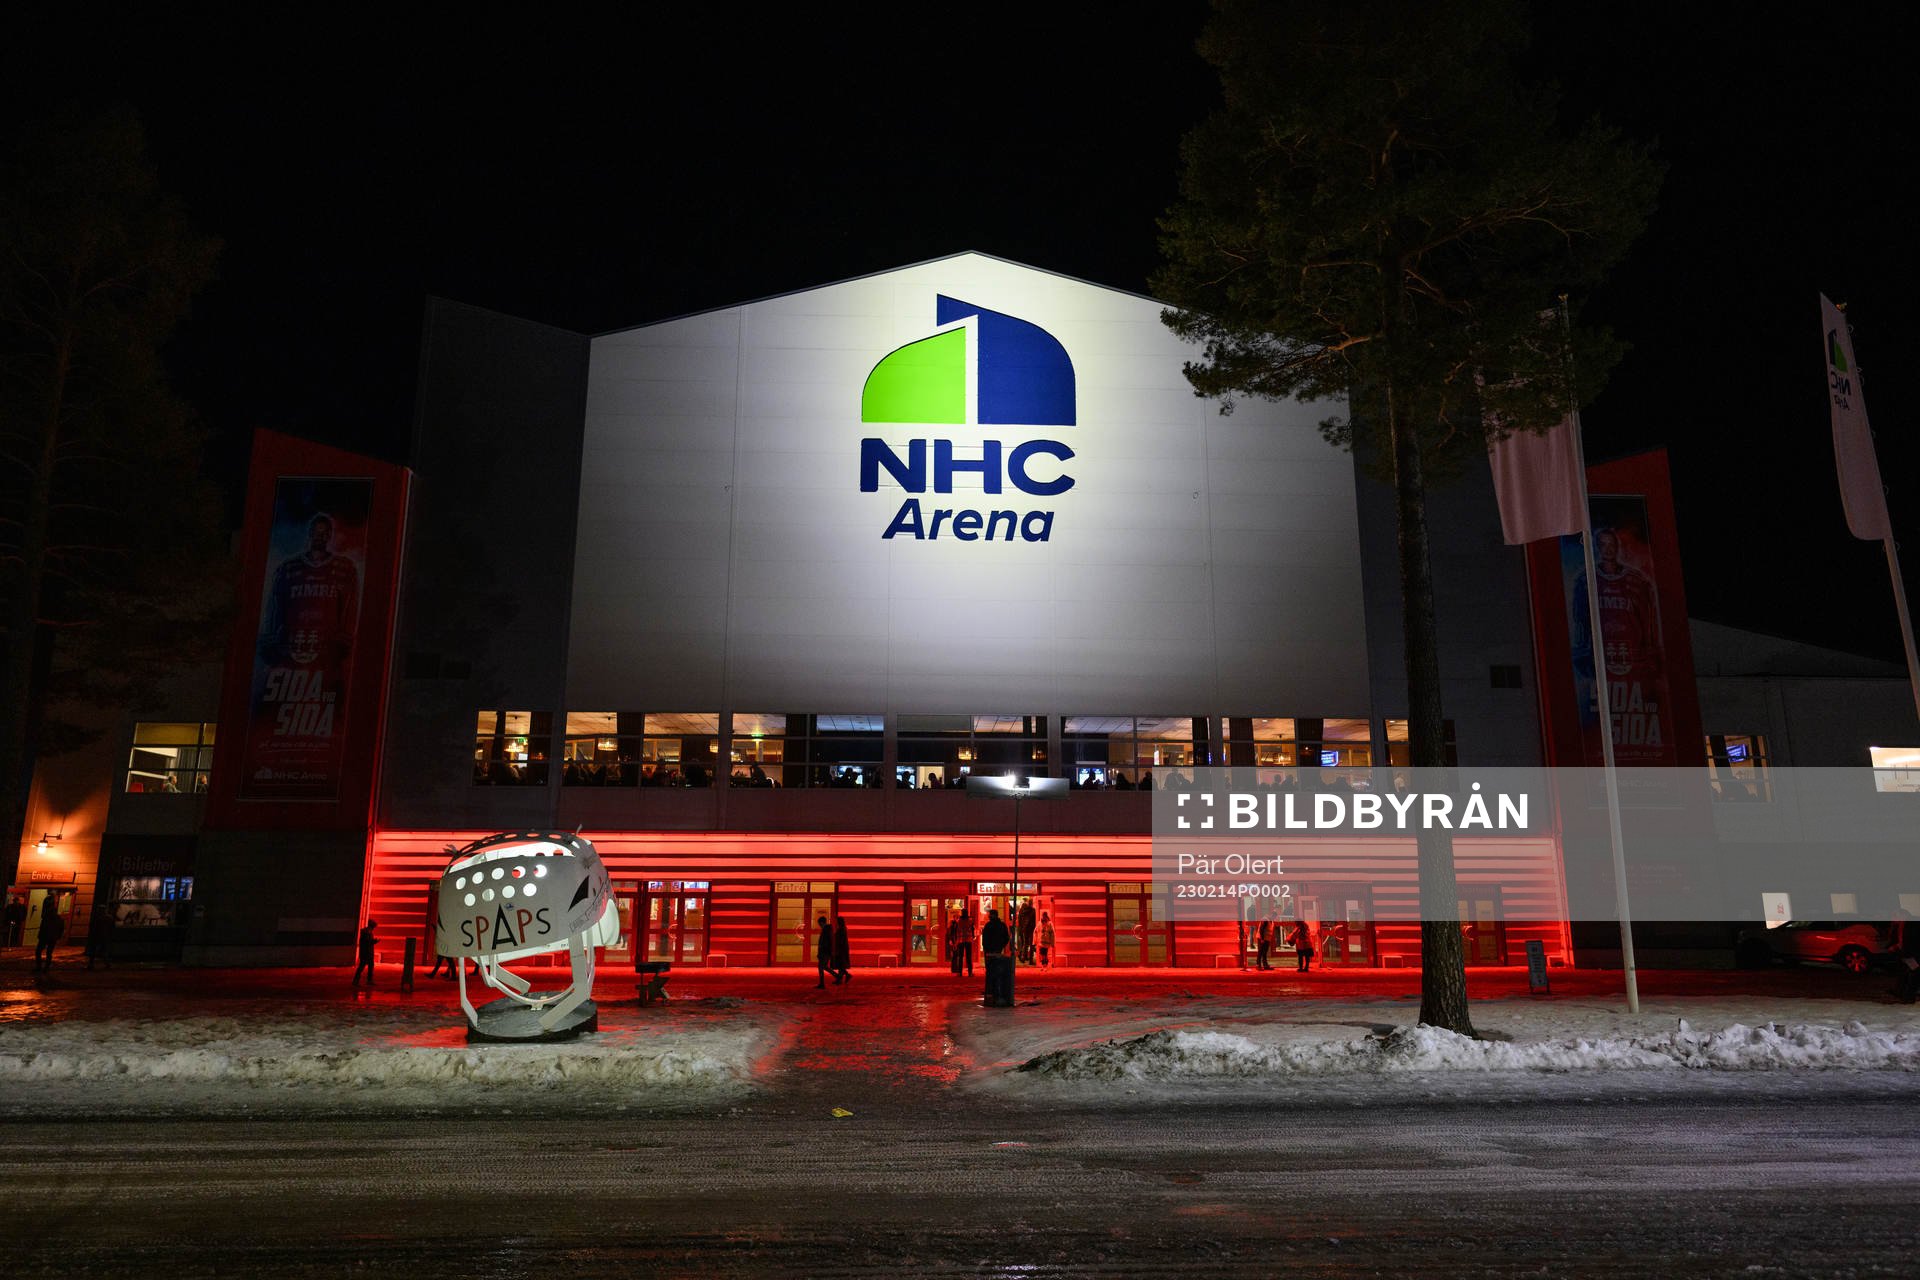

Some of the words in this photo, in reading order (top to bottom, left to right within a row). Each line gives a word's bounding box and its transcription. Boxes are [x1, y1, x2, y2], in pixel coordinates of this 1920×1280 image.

[860, 438, 1075, 496] NHC
[881, 498, 1055, 542] Arena
[263, 668, 324, 701] SIDA
[273, 702, 335, 737] SIDA
[776, 882, 806, 892] Entré
[460, 903, 551, 950] SPAPS
